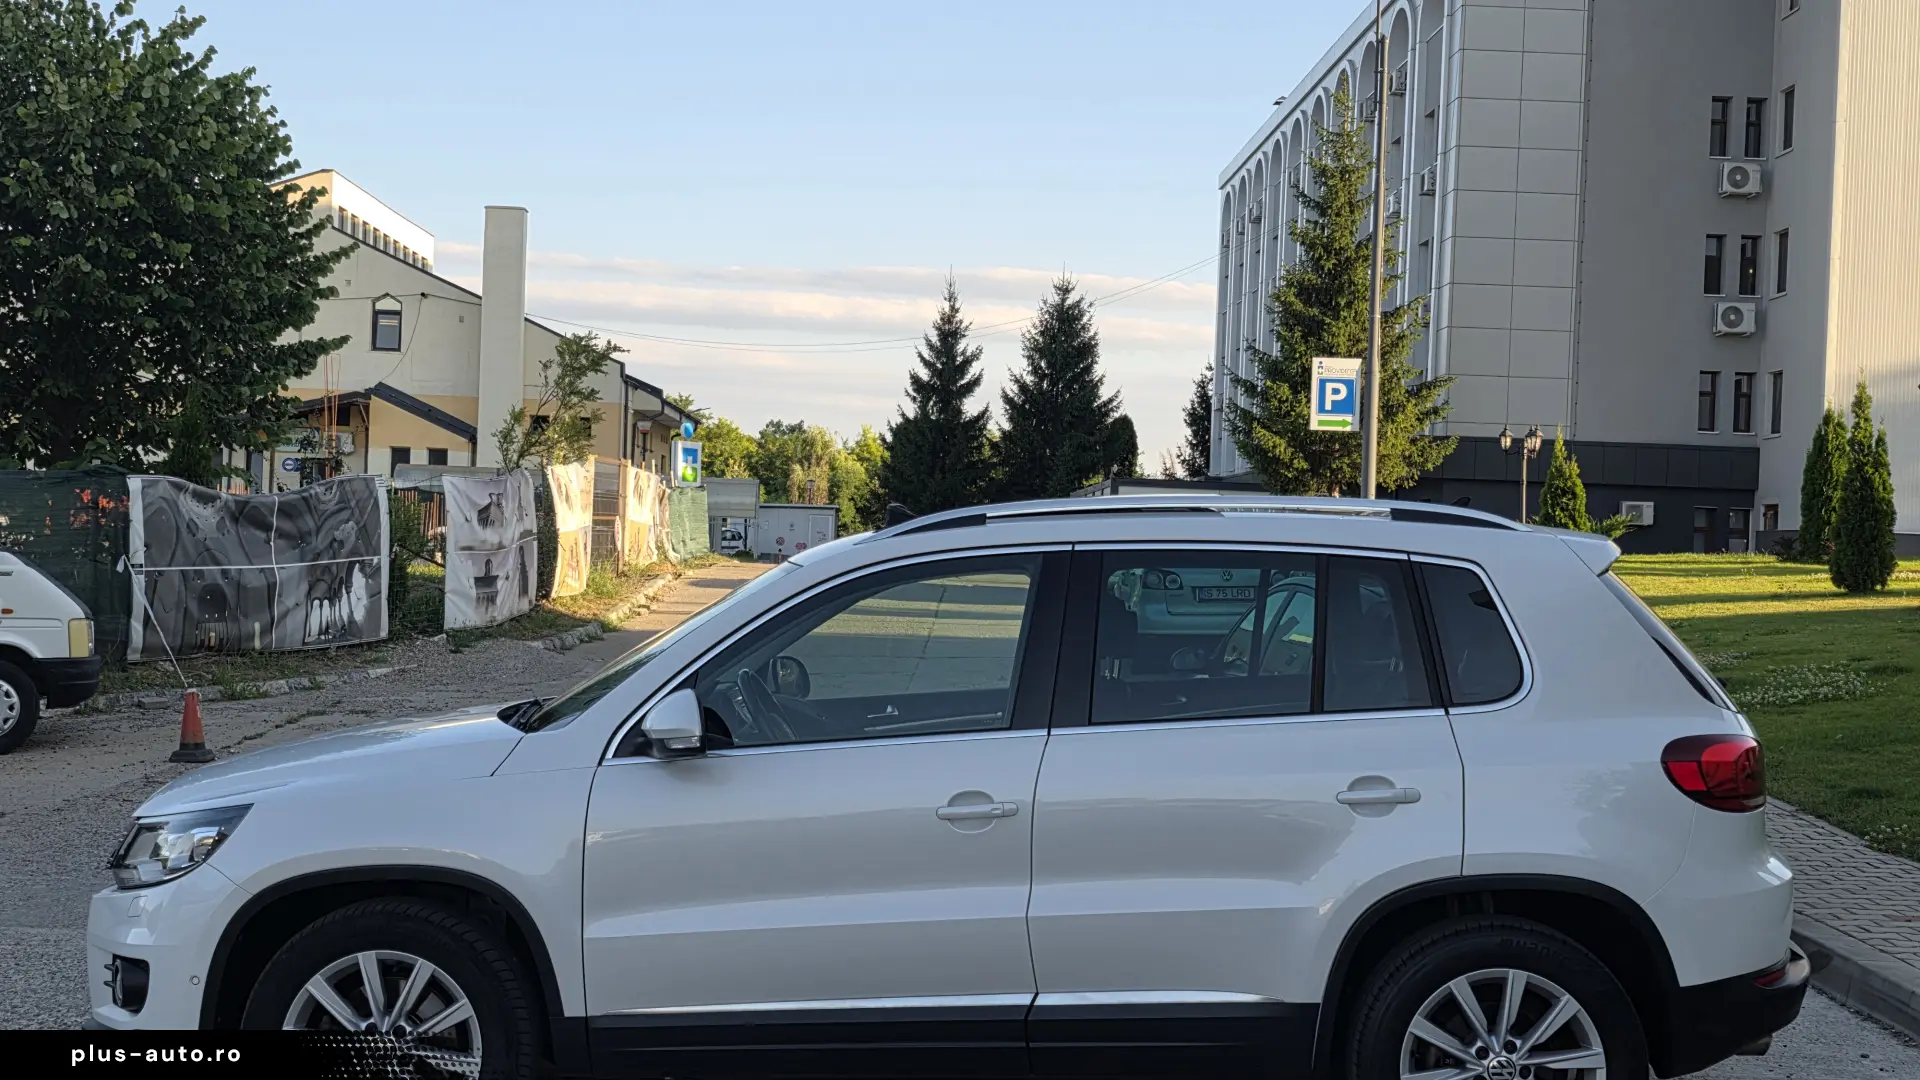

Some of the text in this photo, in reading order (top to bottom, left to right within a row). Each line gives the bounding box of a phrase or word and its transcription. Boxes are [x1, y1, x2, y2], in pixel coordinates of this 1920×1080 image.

[1324, 382, 1348, 411] P
[1216, 588, 1228, 598] 75
[1231, 588, 1251, 598] LRD
